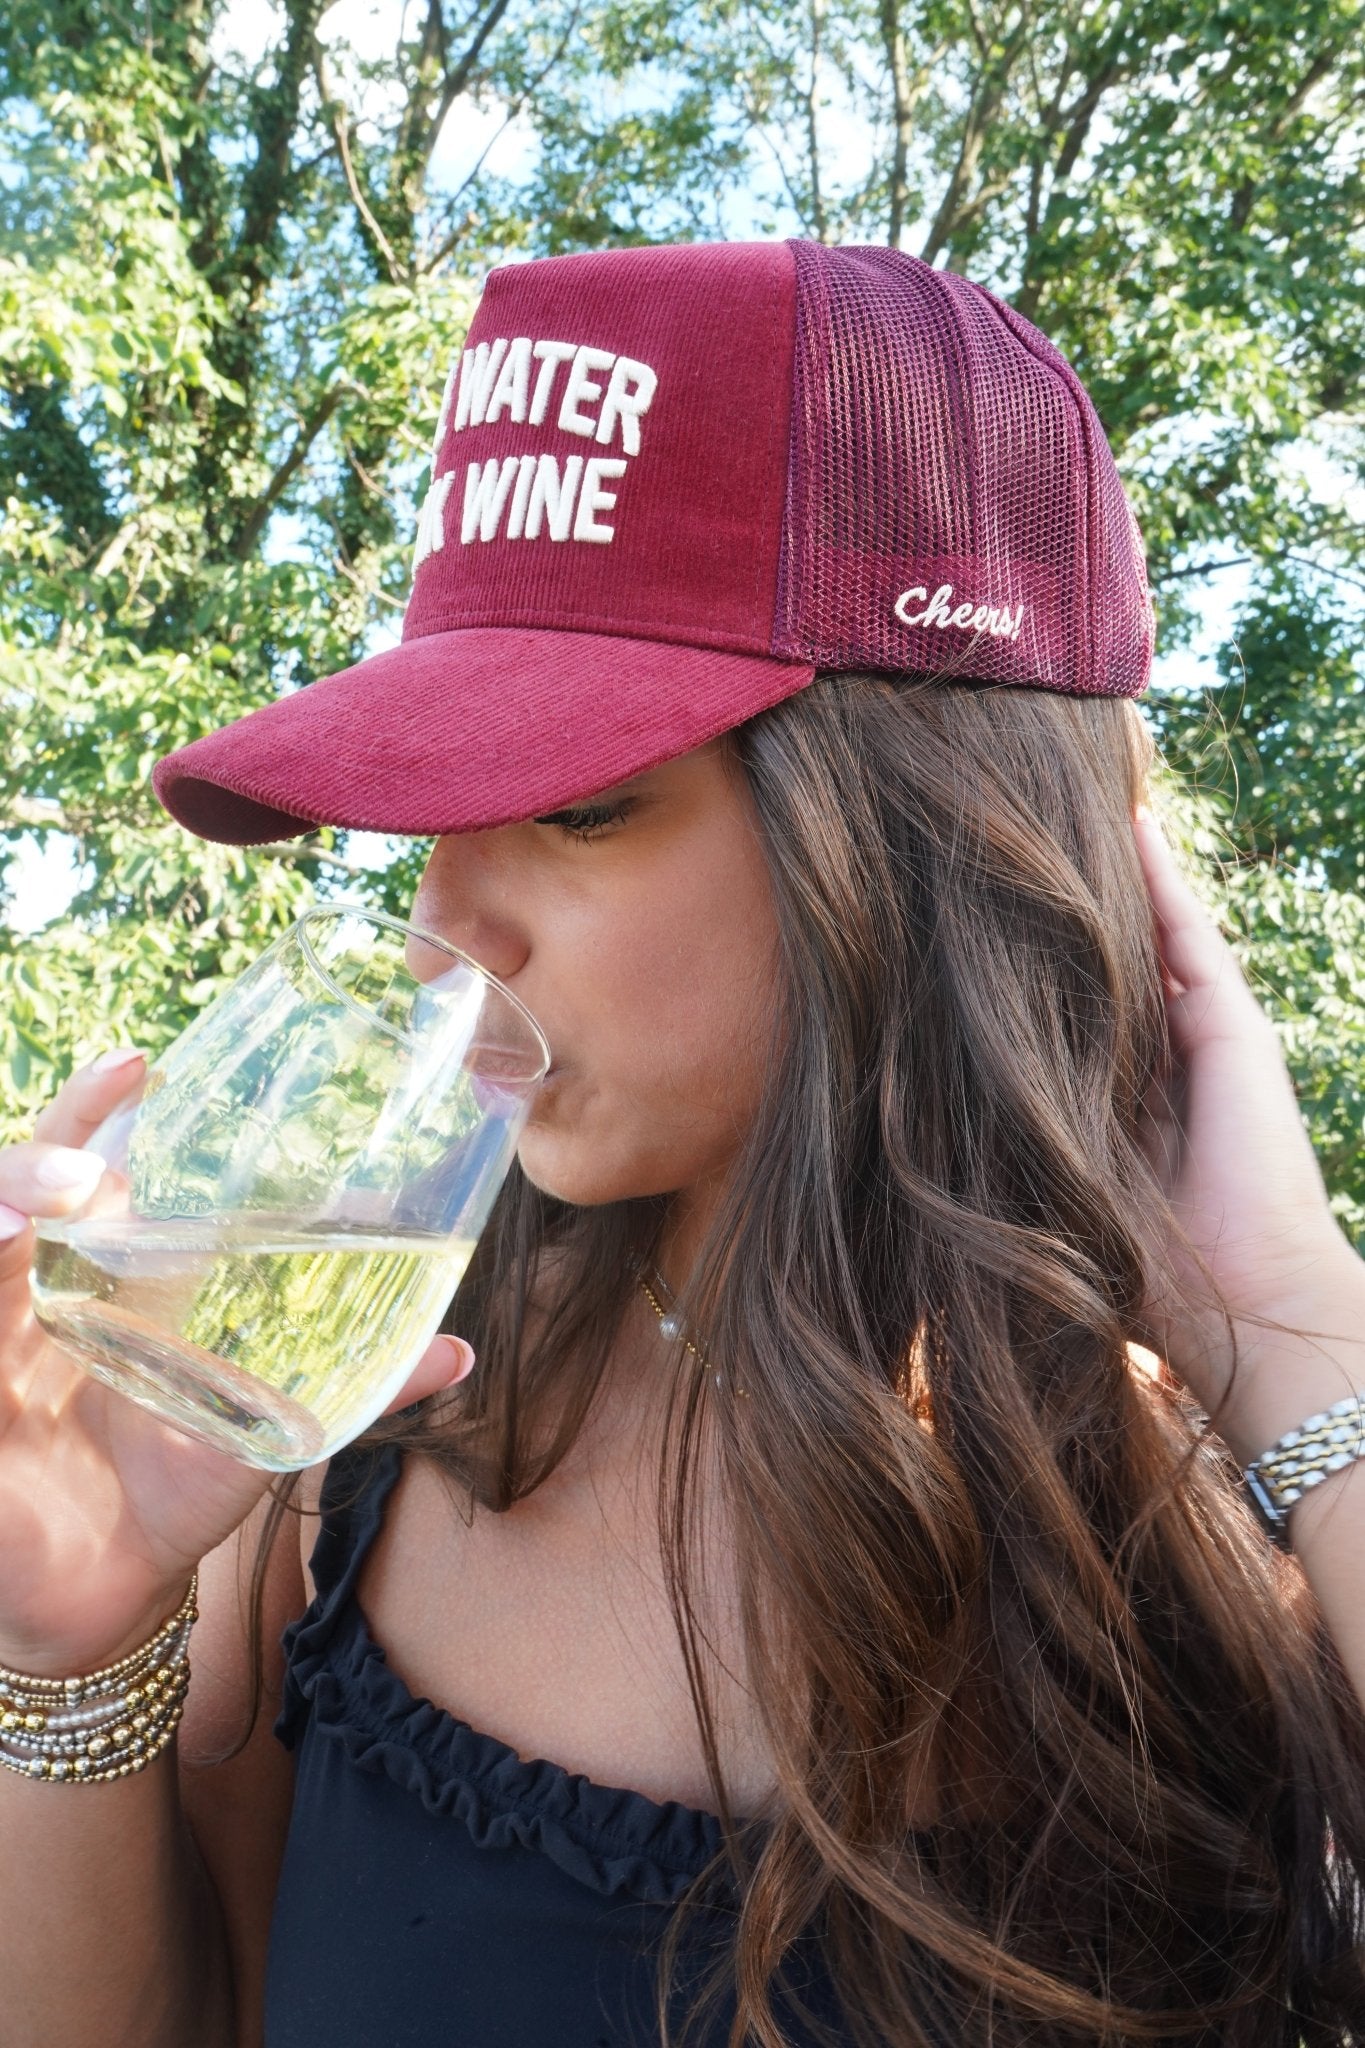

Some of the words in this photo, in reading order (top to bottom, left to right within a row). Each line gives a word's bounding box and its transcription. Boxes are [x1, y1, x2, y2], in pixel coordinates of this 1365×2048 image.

[454, 337, 658, 456] WATER
[460, 453, 628, 544] WINE
[894, 584, 1025, 641] Cheers!
